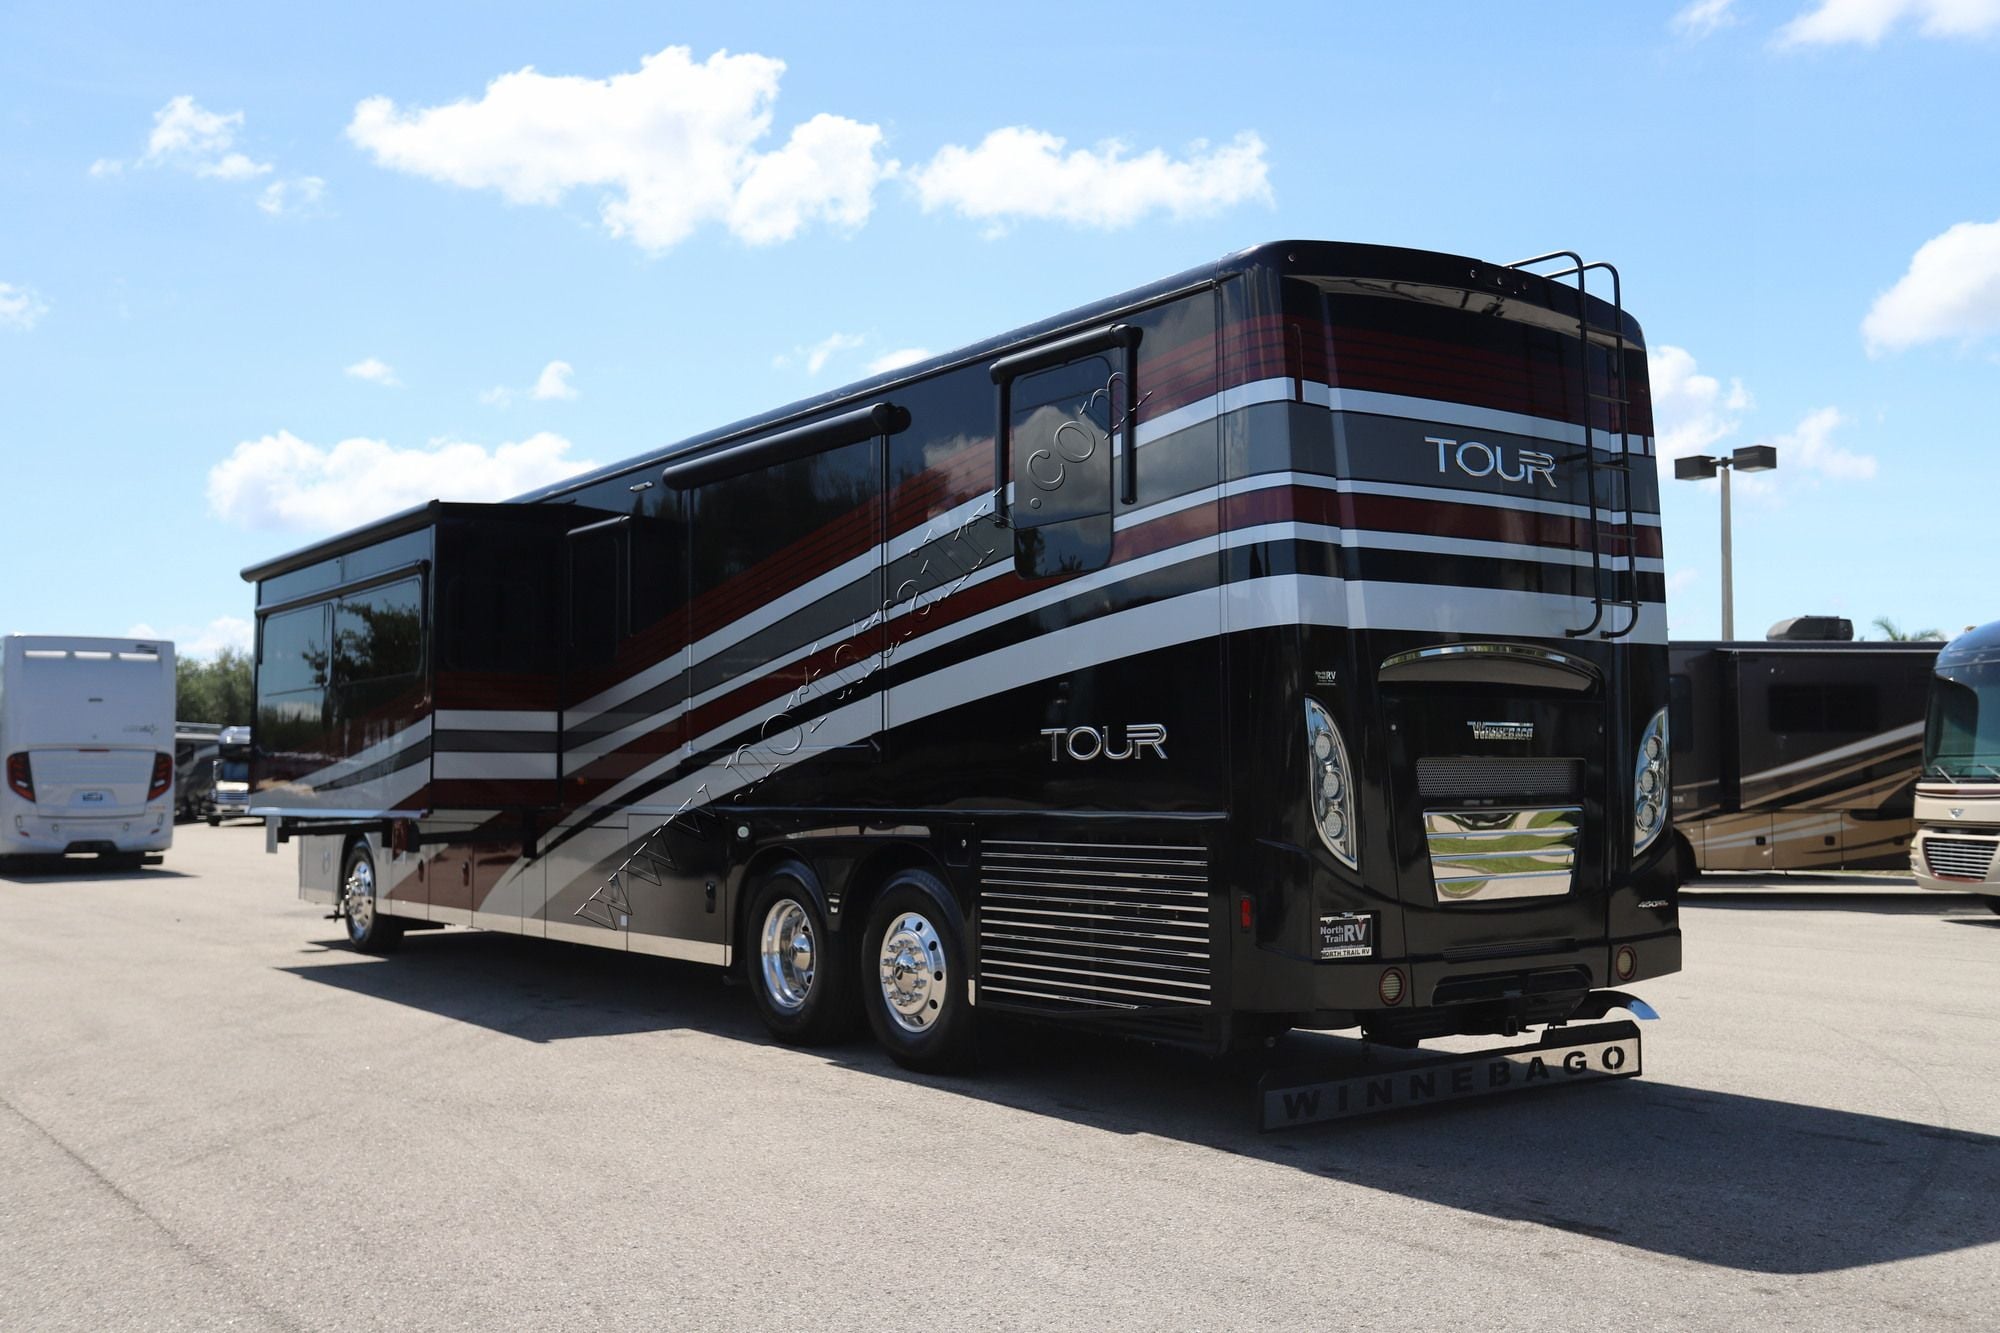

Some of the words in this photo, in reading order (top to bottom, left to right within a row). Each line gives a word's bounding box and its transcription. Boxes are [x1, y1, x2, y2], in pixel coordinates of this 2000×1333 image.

[1424, 436, 1557, 488] TOUR
[1040, 723, 1168, 762] TOUR
[1320, 926, 1343, 935] North
[1344, 924, 1366, 942] RV
[1325, 935, 1344, 943] Trail
[1320, 950, 1342, 958] NORTH
[1282, 1045, 1626, 1121] WINNEBAGO
